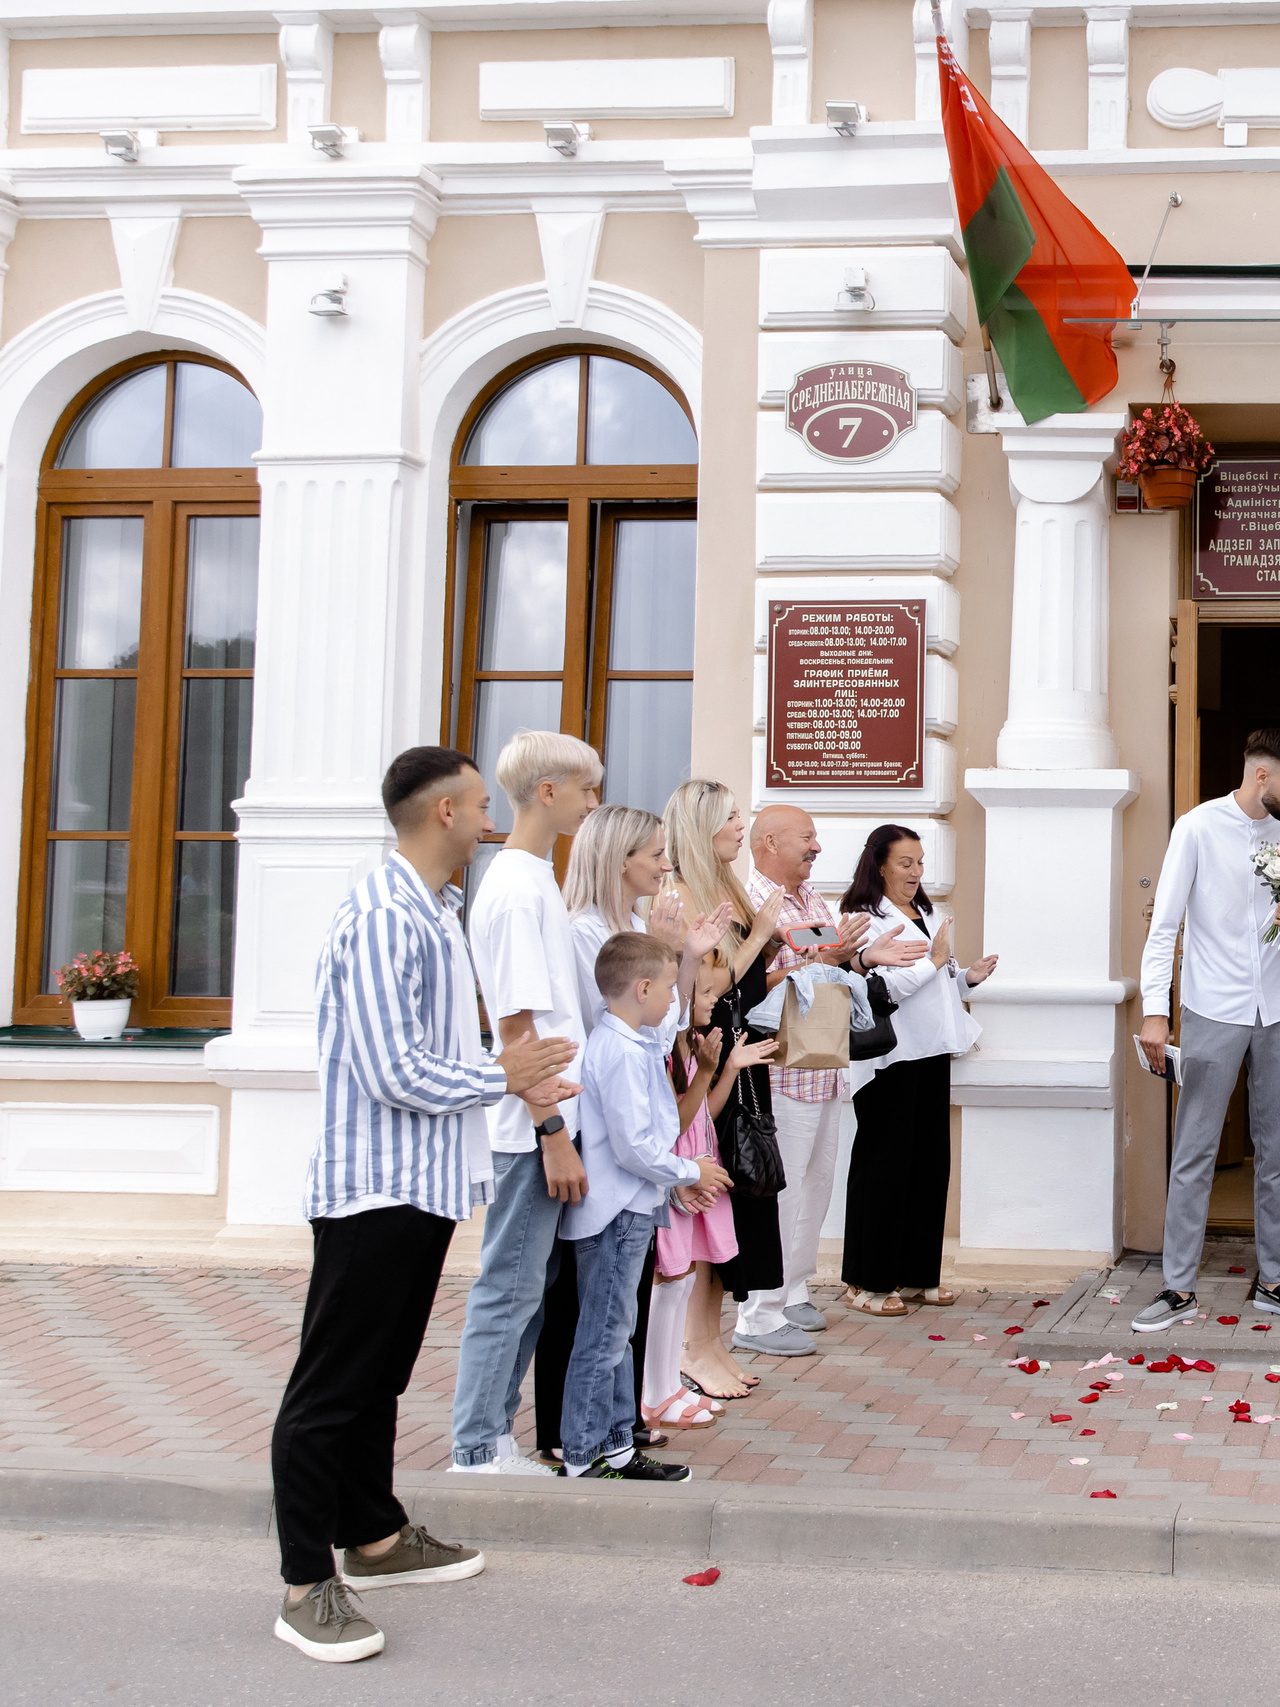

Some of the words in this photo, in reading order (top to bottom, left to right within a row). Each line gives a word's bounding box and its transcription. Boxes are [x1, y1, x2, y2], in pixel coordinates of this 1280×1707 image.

[830, 367, 873, 379] улица
[792, 380, 910, 413] СРЕДНЕНАБЕРЕЖНАЯ
[839, 418, 862, 448] 7
[1220, 471, 1268, 481] Віцебскі
[1215, 483, 1280, 494] выканаўчы
[1209, 539, 1253, 552] АДДЗЕЛ
[802, 614, 841, 622] РЕЖИМ
[846, 614, 894, 622] РАБОТЫ:
[855, 626, 894, 635] 14.00-20.00
[870, 637, 907, 646] 14.00-17.00
[804, 669, 843, 678] ГРАФИК
[848, 667, 889, 678] ПРИЁМА
[793, 679, 899, 688] ЗАИНТЕРЕСОВАННЫХ
[834, 689, 858, 698] ЛИЦ:
[860, 698, 905, 707] 14.00-20.00
[857, 709, 899, 718] 14.00-17.00
[813, 720, 858, 729] 08.00-13.00
